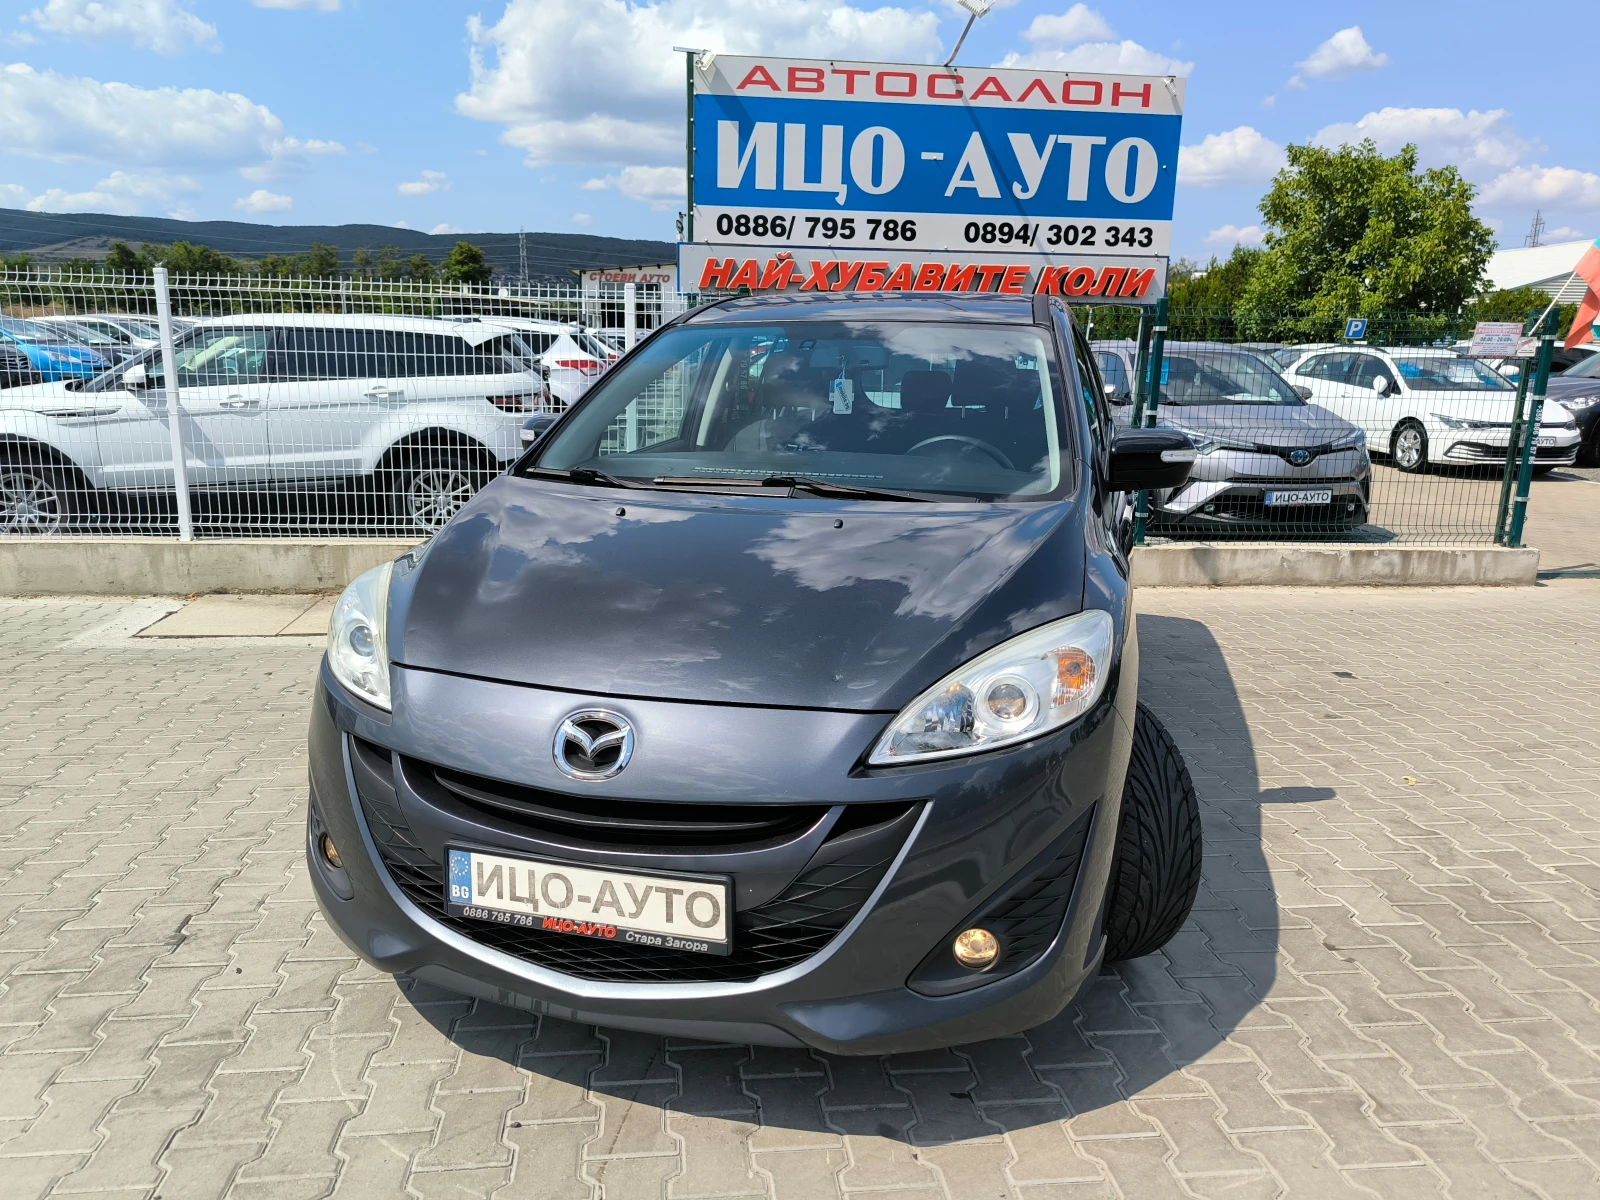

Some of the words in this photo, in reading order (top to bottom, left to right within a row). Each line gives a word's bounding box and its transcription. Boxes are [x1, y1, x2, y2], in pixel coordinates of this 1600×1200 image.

[736, 65, 1152, 108] АВТОСАЛОН
[805, 216, 856, 240] 795
[866, 218, 917, 242] 786
[1046, 224, 1097, 246] 302
[1104, 226, 1153, 247] 343
[589, 272, 636, 283] СТОЕВИ
[639, 273, 670, 283] АУТО
[698, 251, 1031, 293] НАЙ-ХУБАВИТЕ
[1035, 265, 1156, 297] КОЛИ
[1348, 321, 1362, 336] P
[1529, 446, 1537, 455] 57
[1275, 492, 1329, 502] ИЦО-АУТО
[452, 885, 470, 899] BG
[476, 861, 722, 929] ИЦО-АУТО
[463, 907, 488, 920] 0886
[491, 911, 511, 923] 795
[513, 914, 533, 927] 786
[541, 916, 617, 939] ИЦО-АУТО
[625, 931, 662, 947] Стара
[665, 935, 708, 952] Загора
